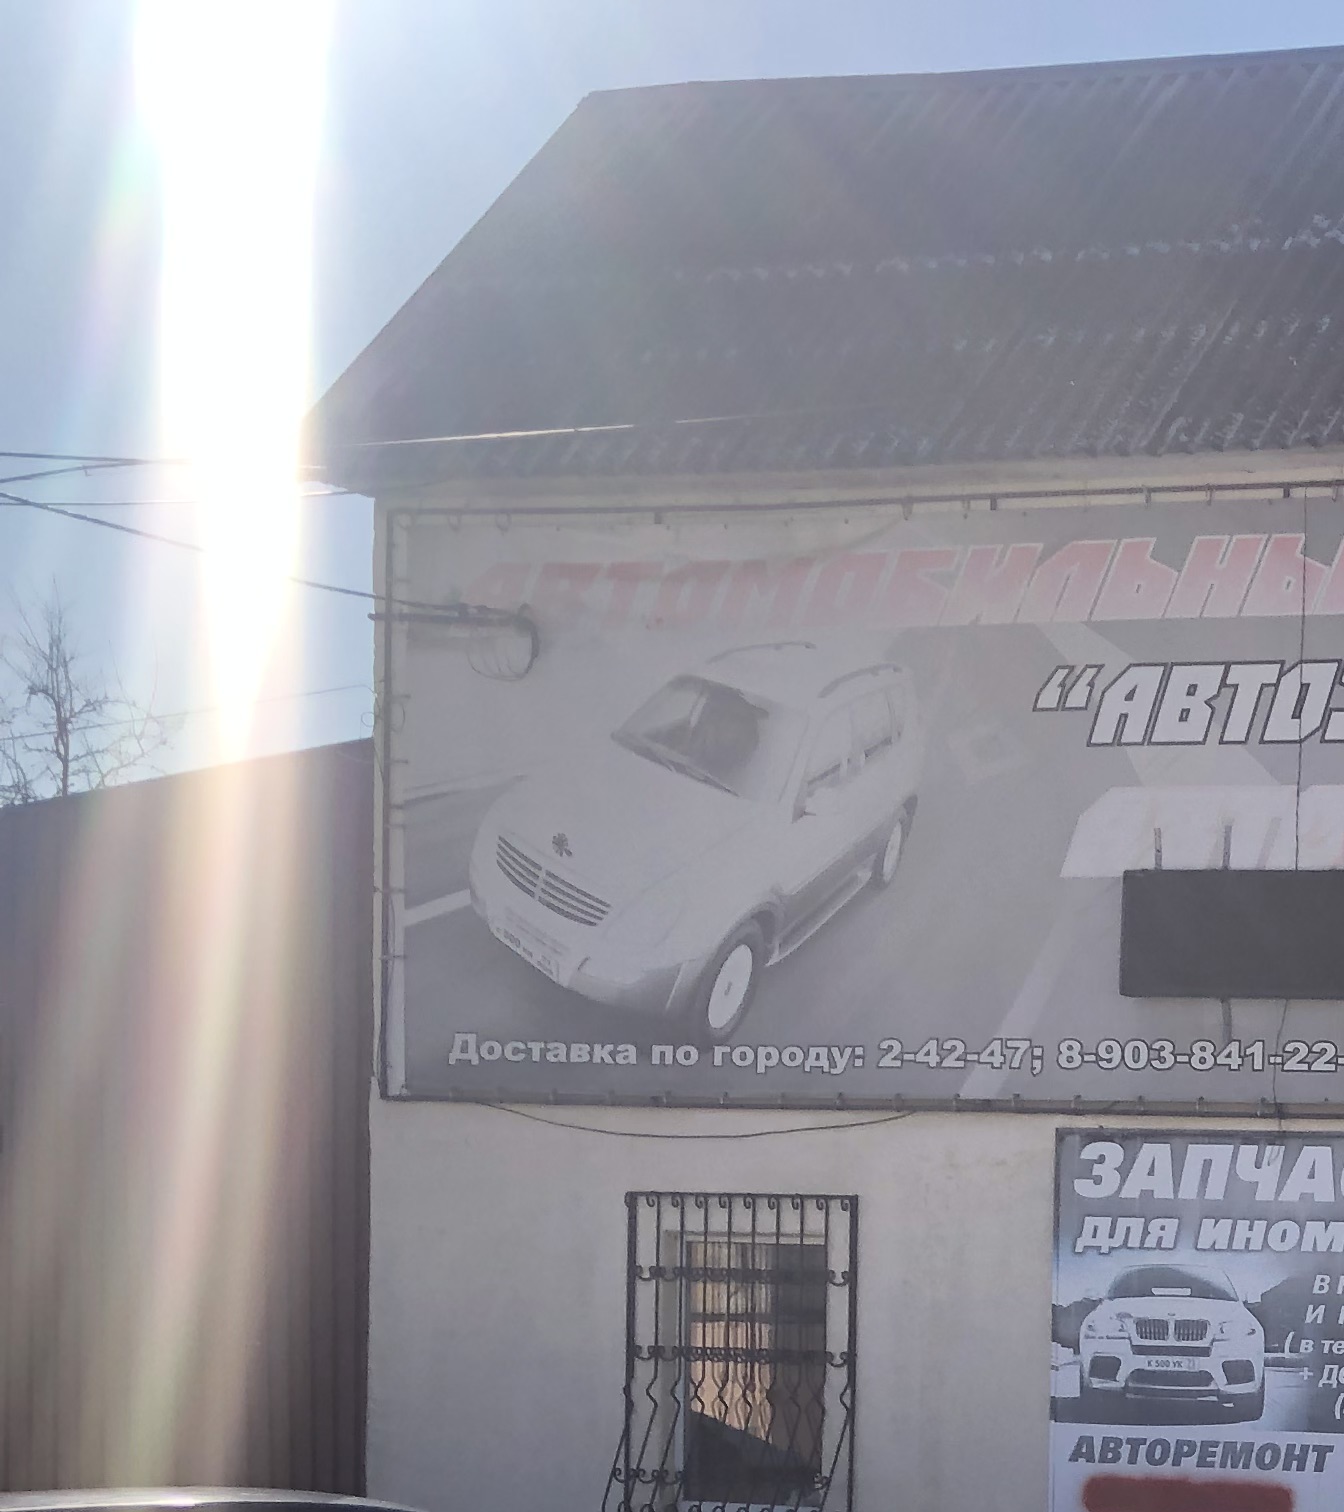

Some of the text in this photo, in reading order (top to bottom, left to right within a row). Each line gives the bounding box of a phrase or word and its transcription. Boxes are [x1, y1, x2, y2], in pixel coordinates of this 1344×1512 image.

[449, 1033, 637, 1066] Доставка
[651, 1043, 700, 1067] по
[712, 1042, 864, 1075] городу:
[1075, 1215, 1180, 1254] для
[1312, 1274, 1331, 1295] В
[1305, 1304, 1326, 1324] И
[1068, 1435, 1335, 1473] АВТОРЕМОНТ
